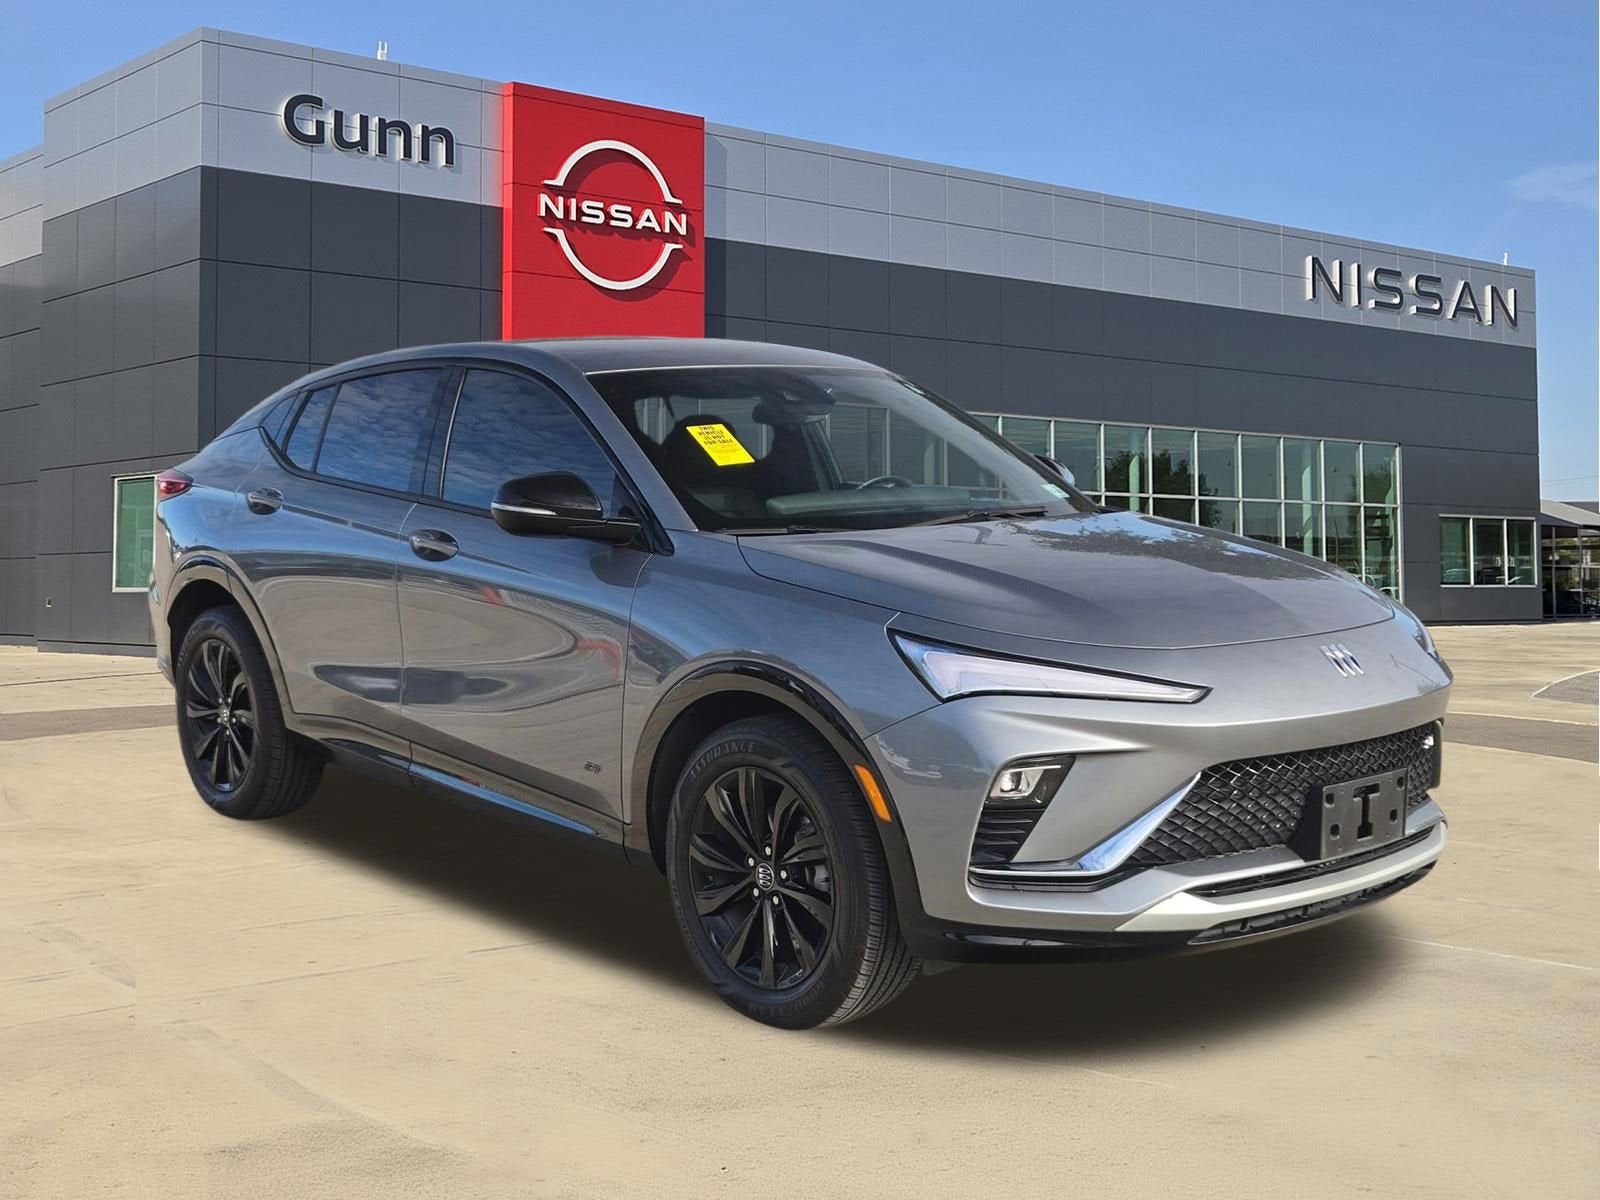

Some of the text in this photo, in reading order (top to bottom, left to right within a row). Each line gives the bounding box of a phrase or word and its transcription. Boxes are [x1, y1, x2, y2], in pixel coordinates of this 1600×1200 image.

[282, 93, 456, 168] Gunn
[537, 193, 688, 237] NISSAN
[1305, 255, 1519, 328] NISSAN
